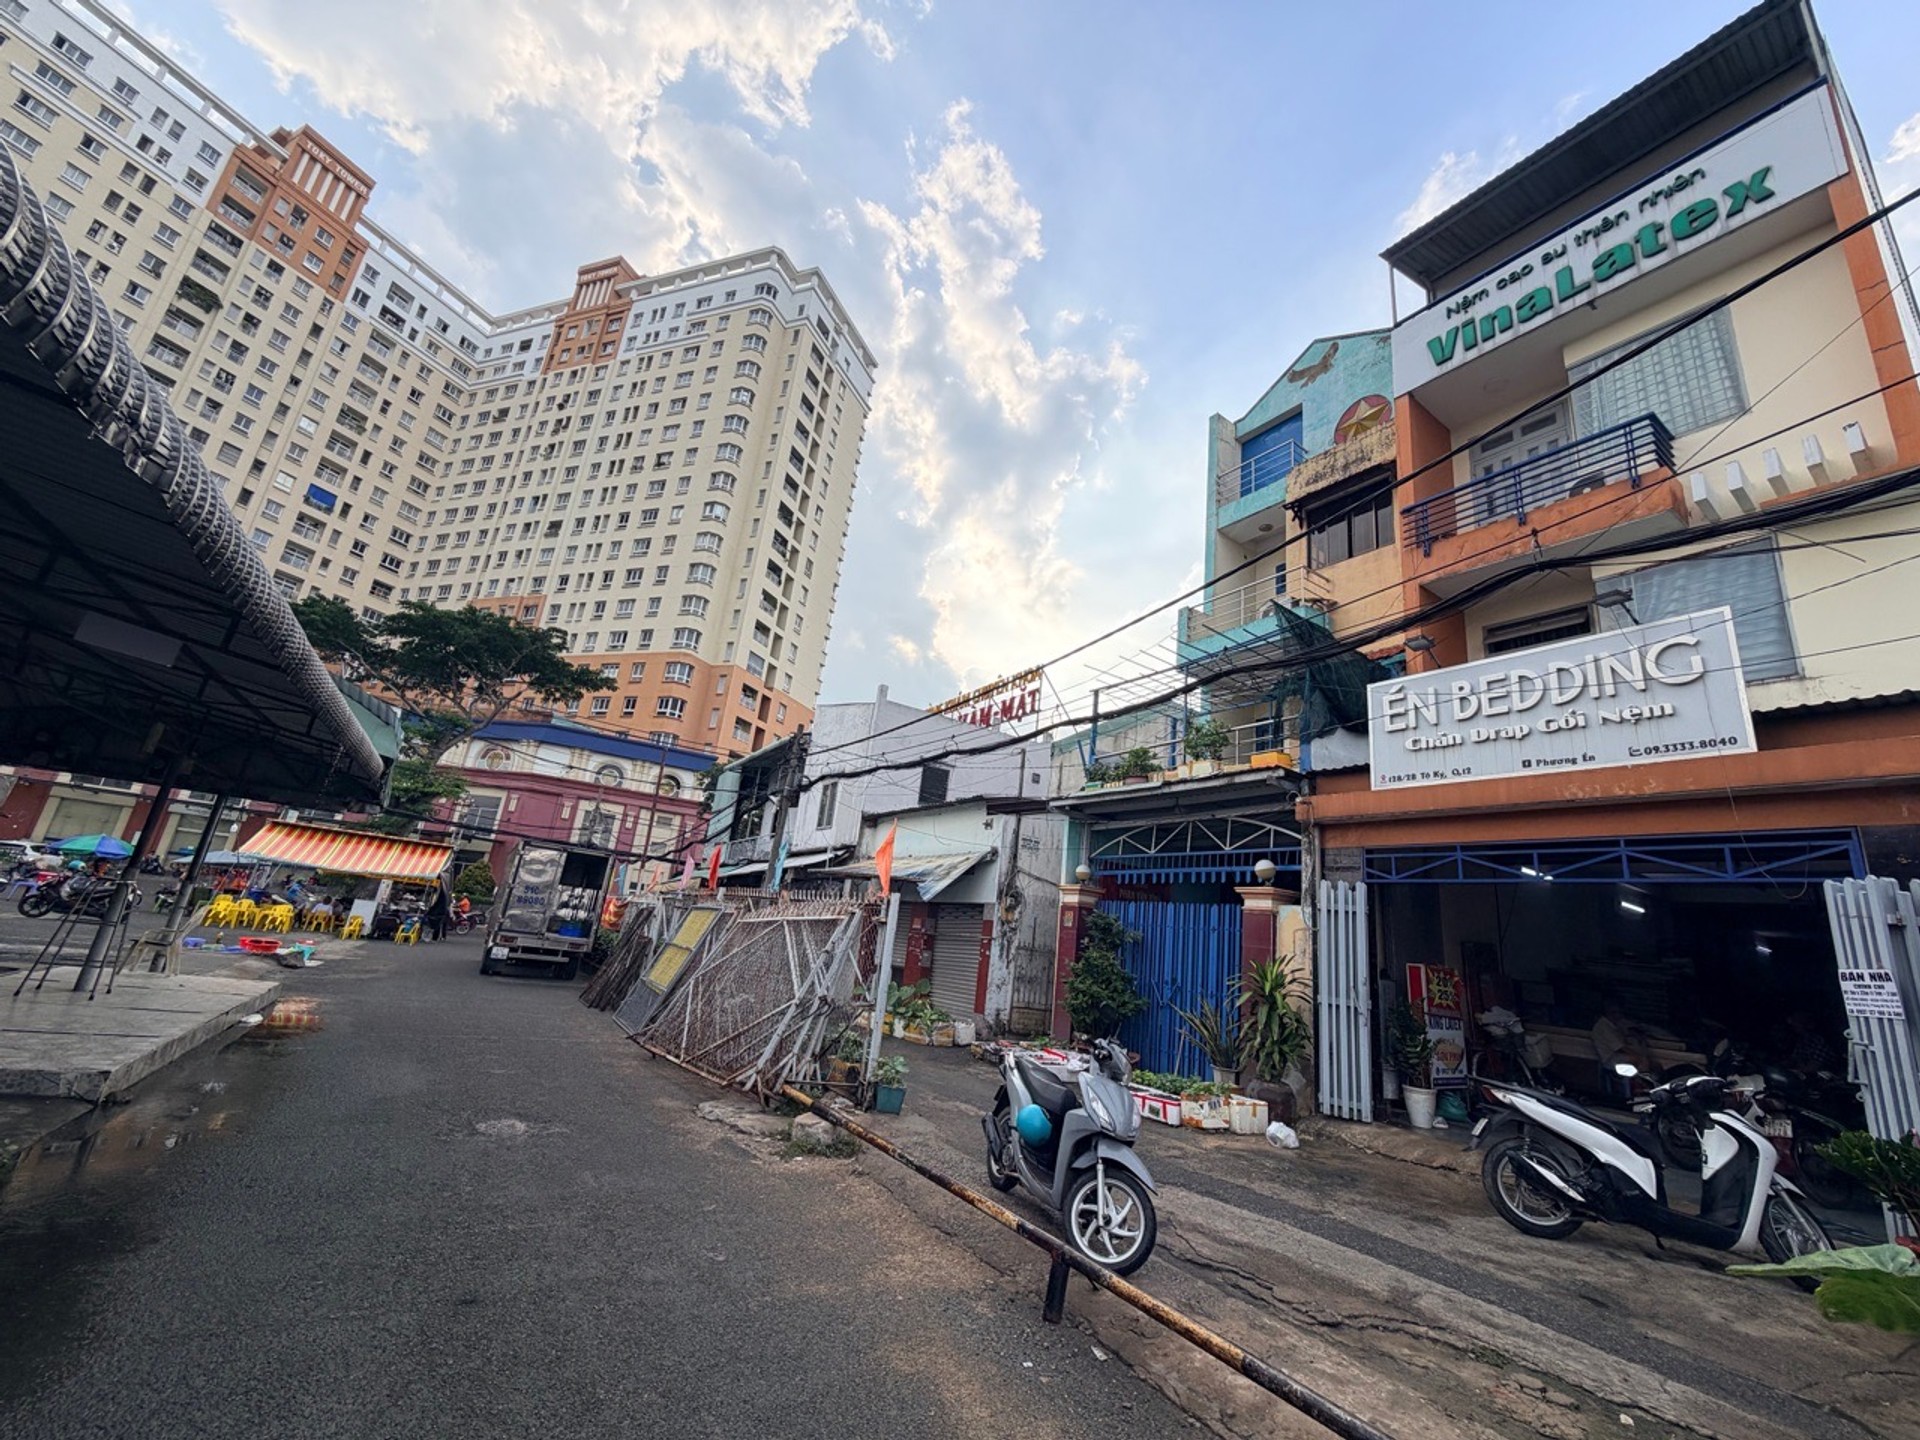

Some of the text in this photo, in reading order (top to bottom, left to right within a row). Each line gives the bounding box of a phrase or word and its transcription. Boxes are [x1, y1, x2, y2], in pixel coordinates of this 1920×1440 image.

[335, 164, 369, 195] TOWER
[1496, 263, 1534, 291] cao
[1541, 243, 1567, 266] su
[1573, 209, 1630, 248] thiên
[1638, 167, 1706, 214] nhiên
[1382, 634, 1706, 734] ÉN BEDDING
[1469, 722, 1531, 744] Drap
[1535, 708, 1588, 734] Gối
[1598, 701, 1676, 726] Nệm
[1535, 755, 1578, 769] Phương
[1644, 736, 1739, 757] 09.3333.8040
